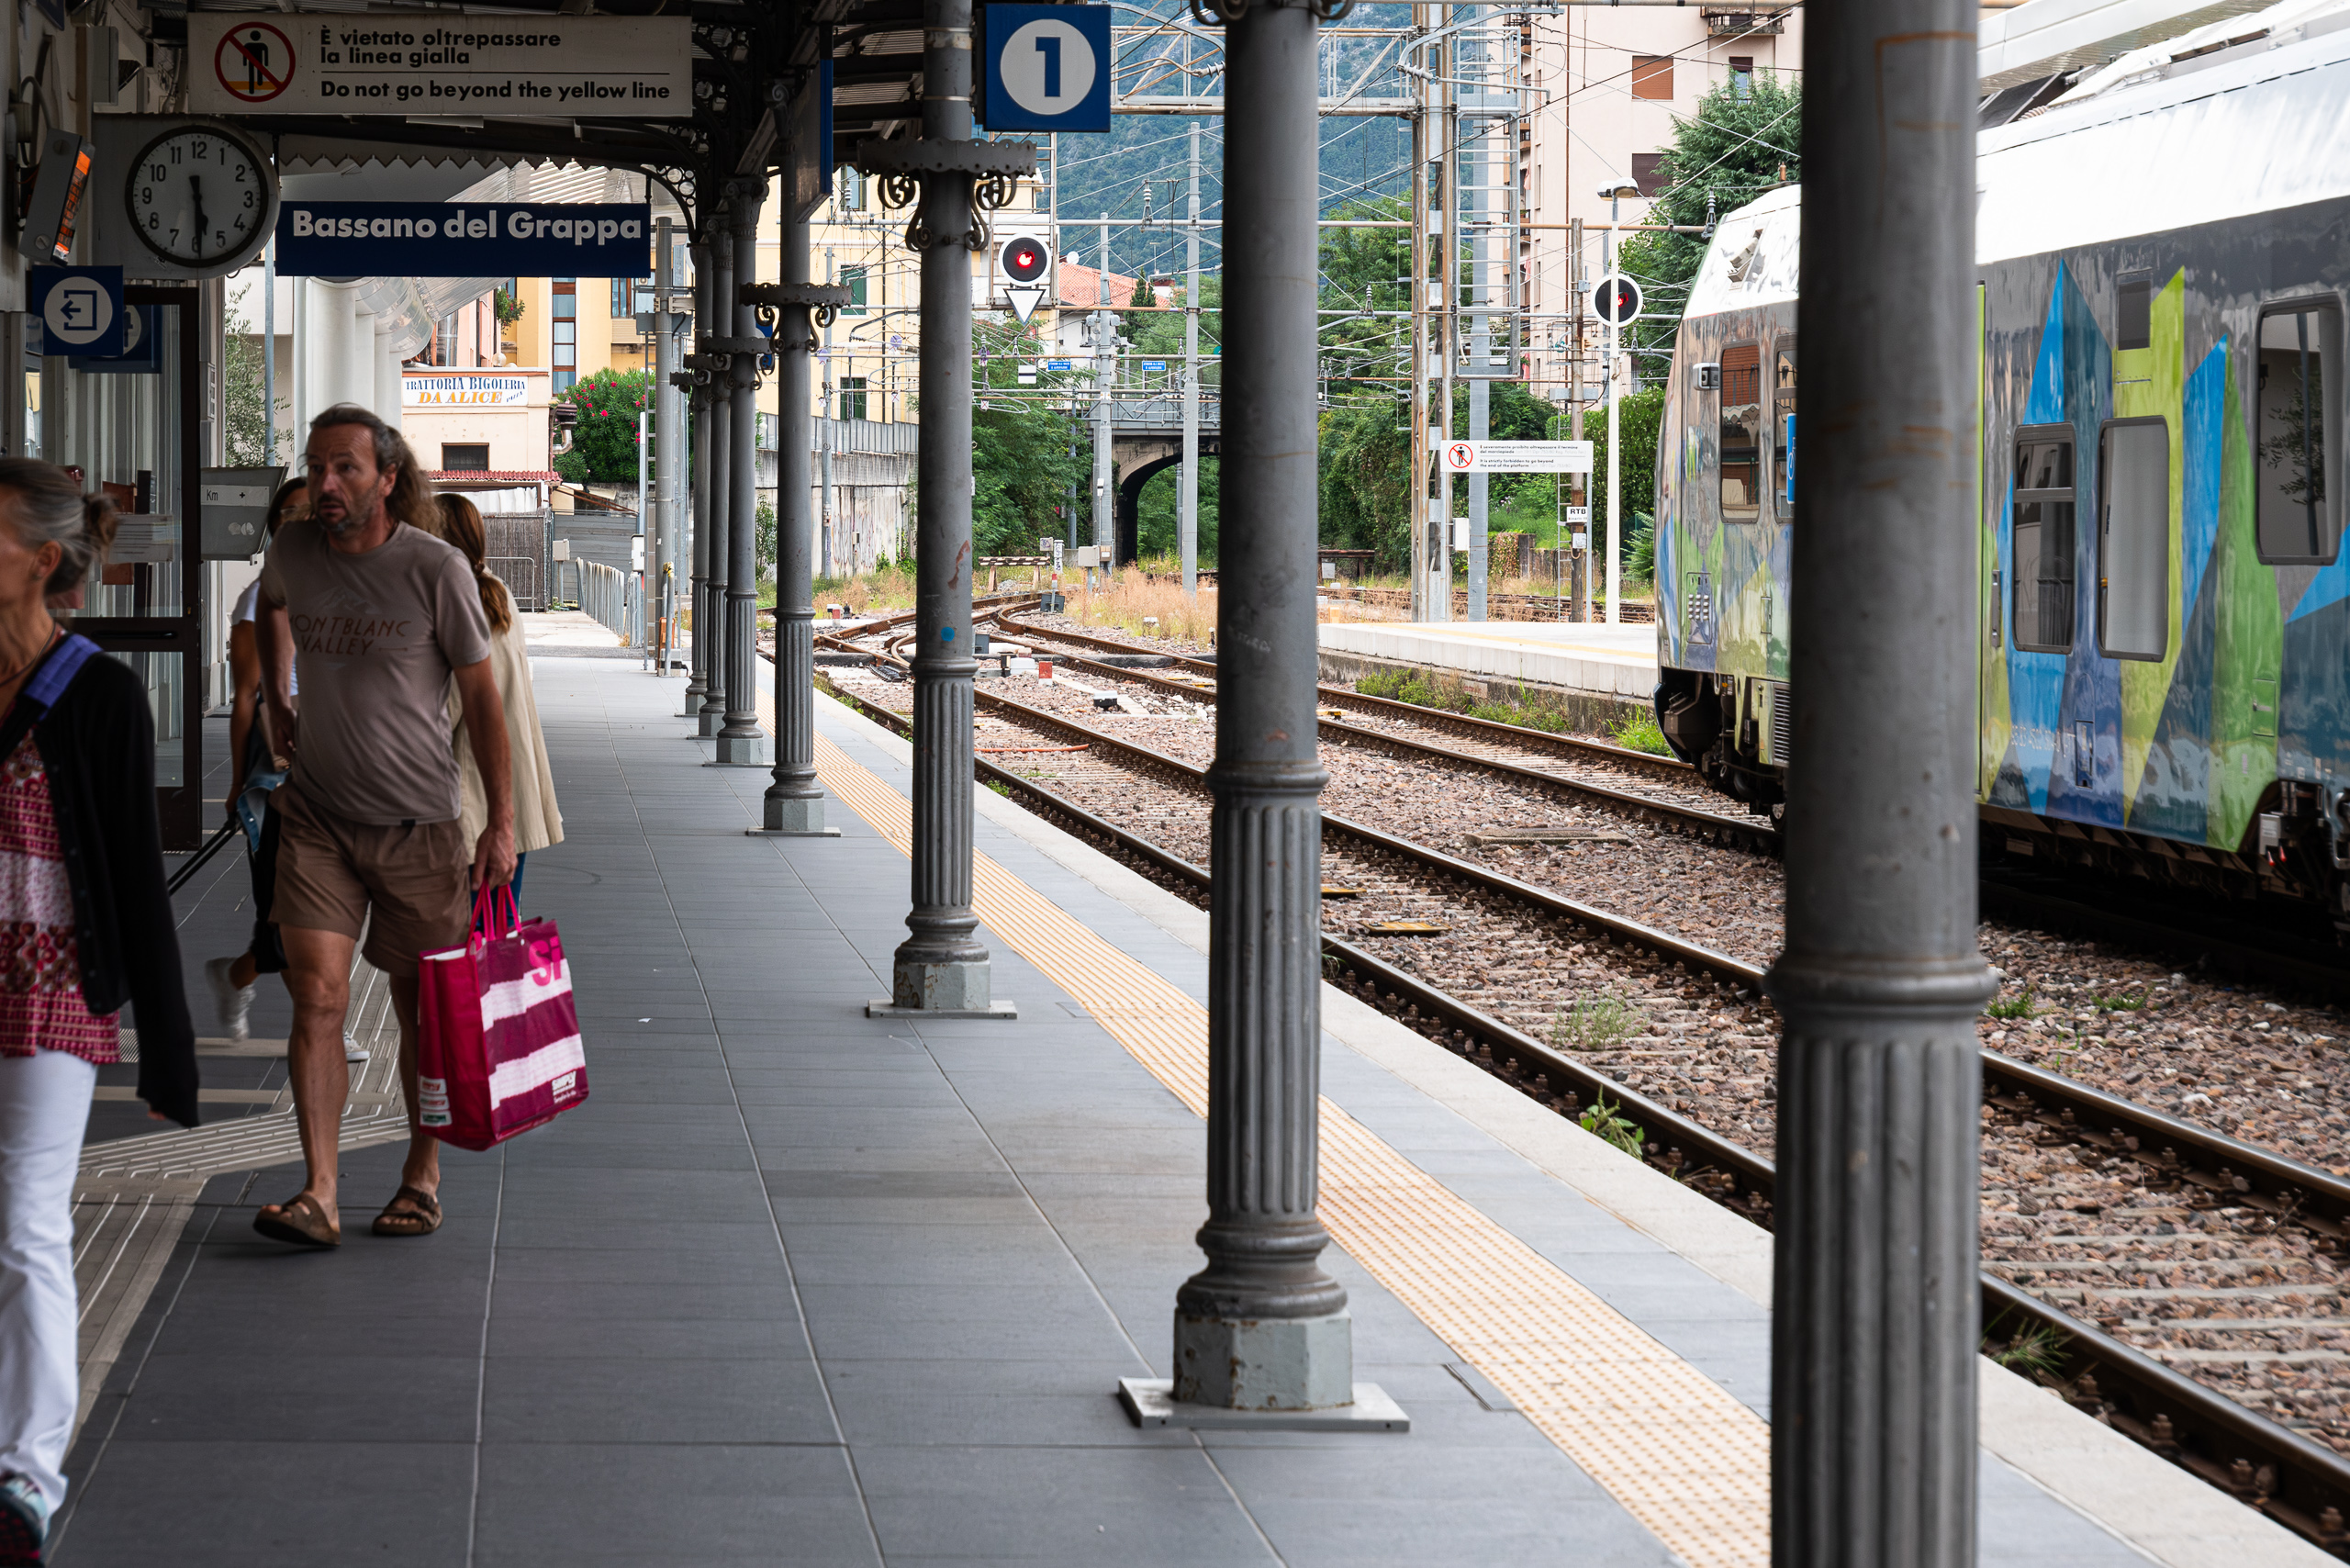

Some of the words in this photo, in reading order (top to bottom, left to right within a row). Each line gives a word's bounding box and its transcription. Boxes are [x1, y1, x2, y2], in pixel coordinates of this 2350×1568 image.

[321, 25, 331, 45] È
[340, 29, 415, 46] vietato
[422, 28, 561, 50] oltrepassare
[321, 47, 340, 64] la
[349, 47, 402, 64] linea
[409, 47, 470, 68] gialla
[1035, 37, 1060, 97] 1
[321, 81, 350, 97] Do
[355, 82, 389, 97] not
[396, 84, 424, 101] go
[430, 81, 512, 101] beyond
[518, 81, 552, 98] the
[558, 81, 627, 102] yellow
[632, 82, 670, 99] line
[170, 146, 181, 164] 11
[191, 140, 207, 160] 12
[219, 147, 225, 166] 1
[150, 164, 166, 182] 10
[235, 164, 246, 182] 2
[142, 186, 152, 204] 9
[243, 190, 253, 208] 3
[149, 212, 159, 230] 8
[233, 213, 246, 232] 4
[293, 210, 437, 238] Bassano
[443, 210, 497, 238] del
[508, 211, 641, 246] Grappa
[169, 228, 180, 247] 7
[216, 230, 226, 248] 5
[406, 377, 464, 390] TRATTORIA
[470, 377, 526, 390] BIGOLERIA
[418, 392, 442, 403] DA
[445, 391, 503, 403] ALICE
[206, 488, 218, 501] Km
[301, 635, 374, 656] VALLEY
